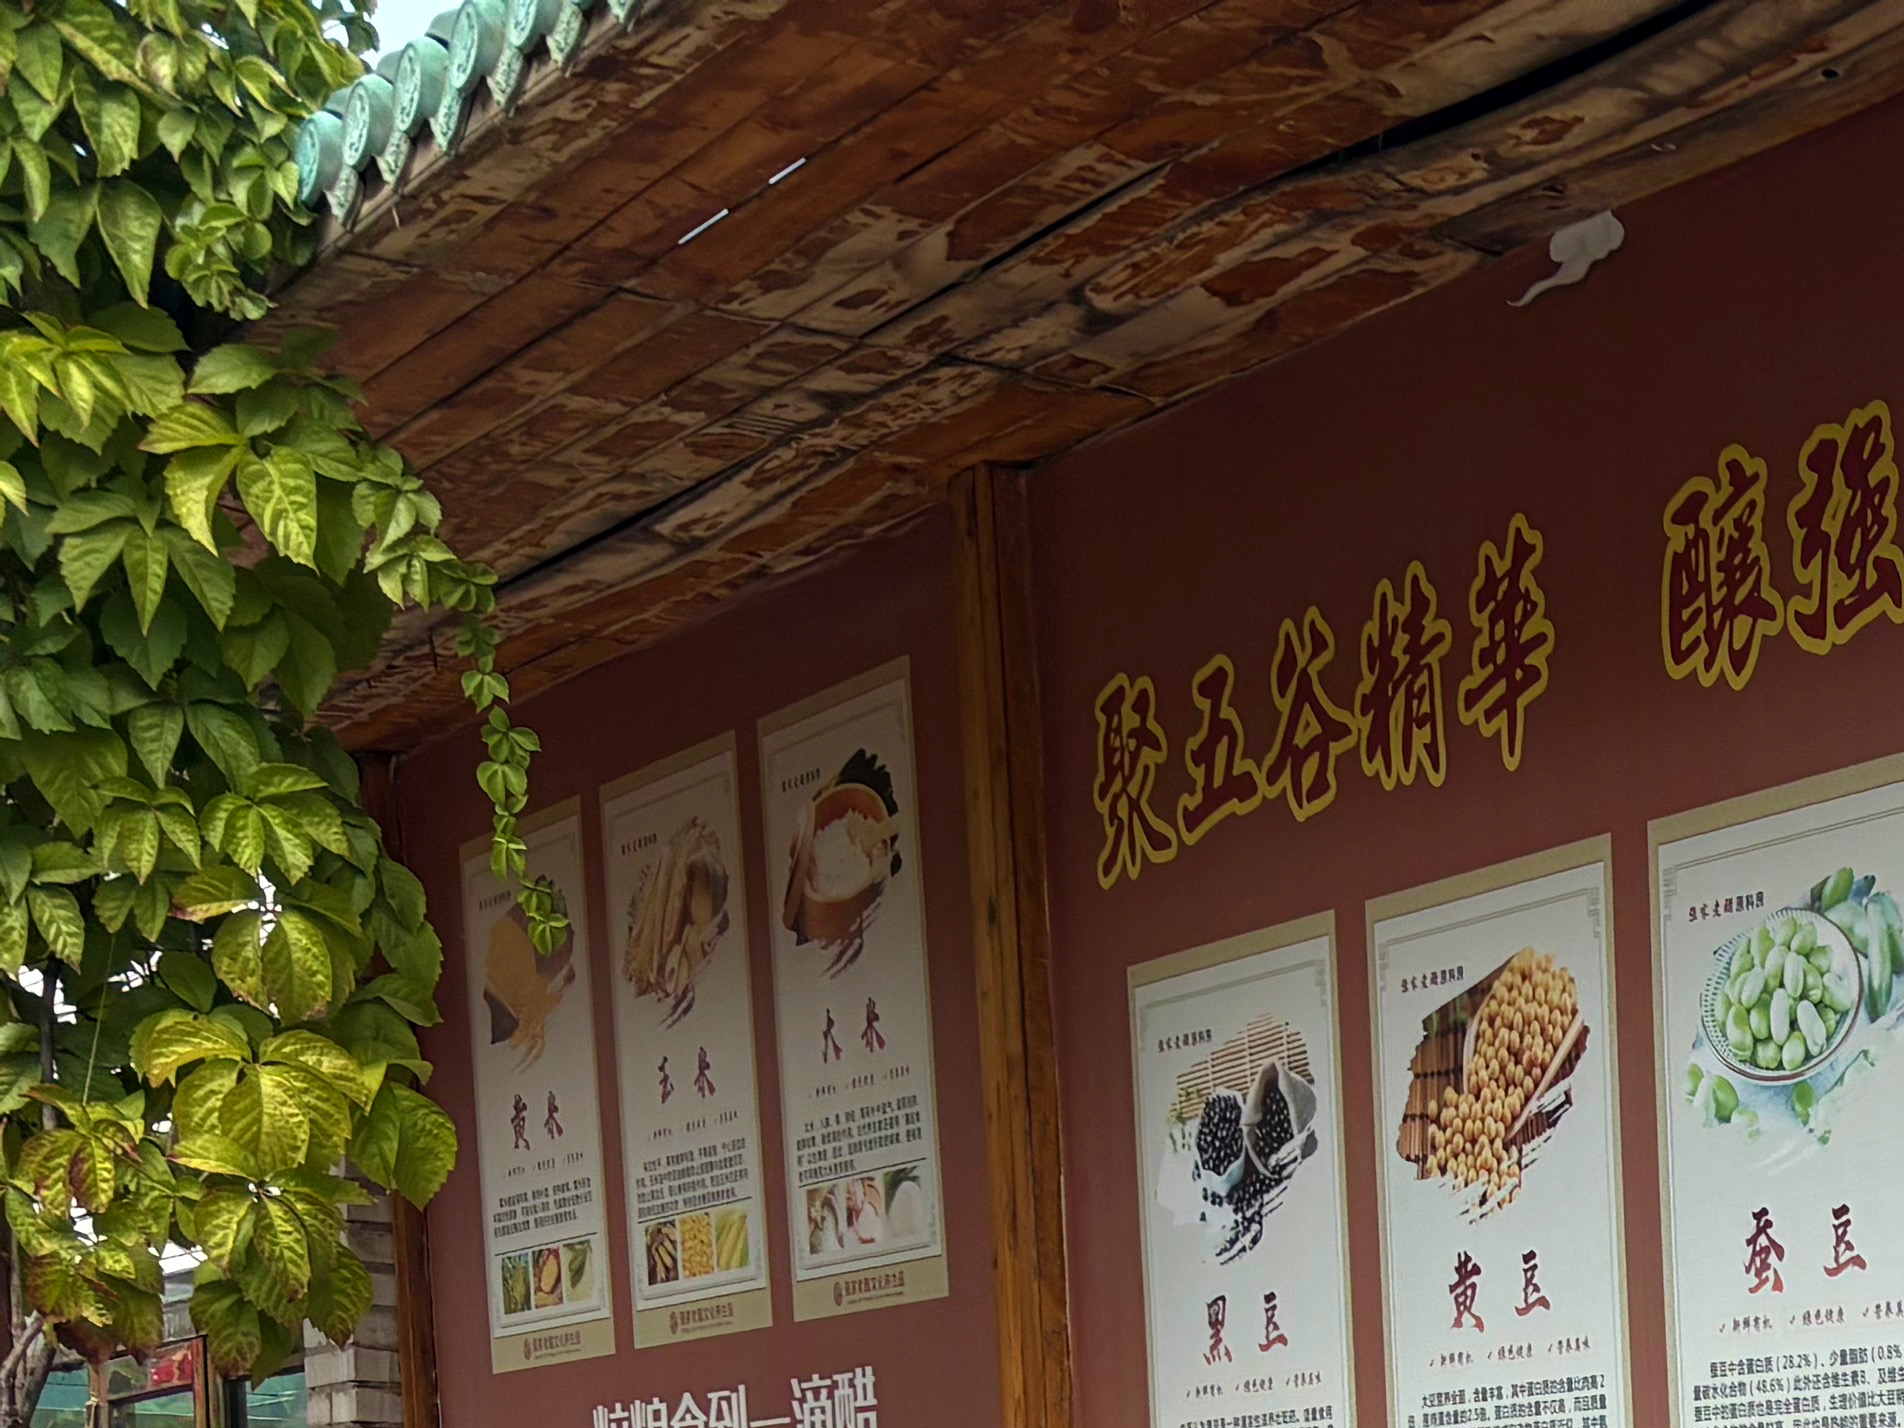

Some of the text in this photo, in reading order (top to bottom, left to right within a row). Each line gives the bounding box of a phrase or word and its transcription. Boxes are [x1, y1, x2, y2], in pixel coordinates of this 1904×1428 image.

[1743, 1203, 1868, 1294] 蚕豆
[1203, 1291, 1288, 1365] 黑豆
[1449, 1249, 1551, 1333] 黄豆
